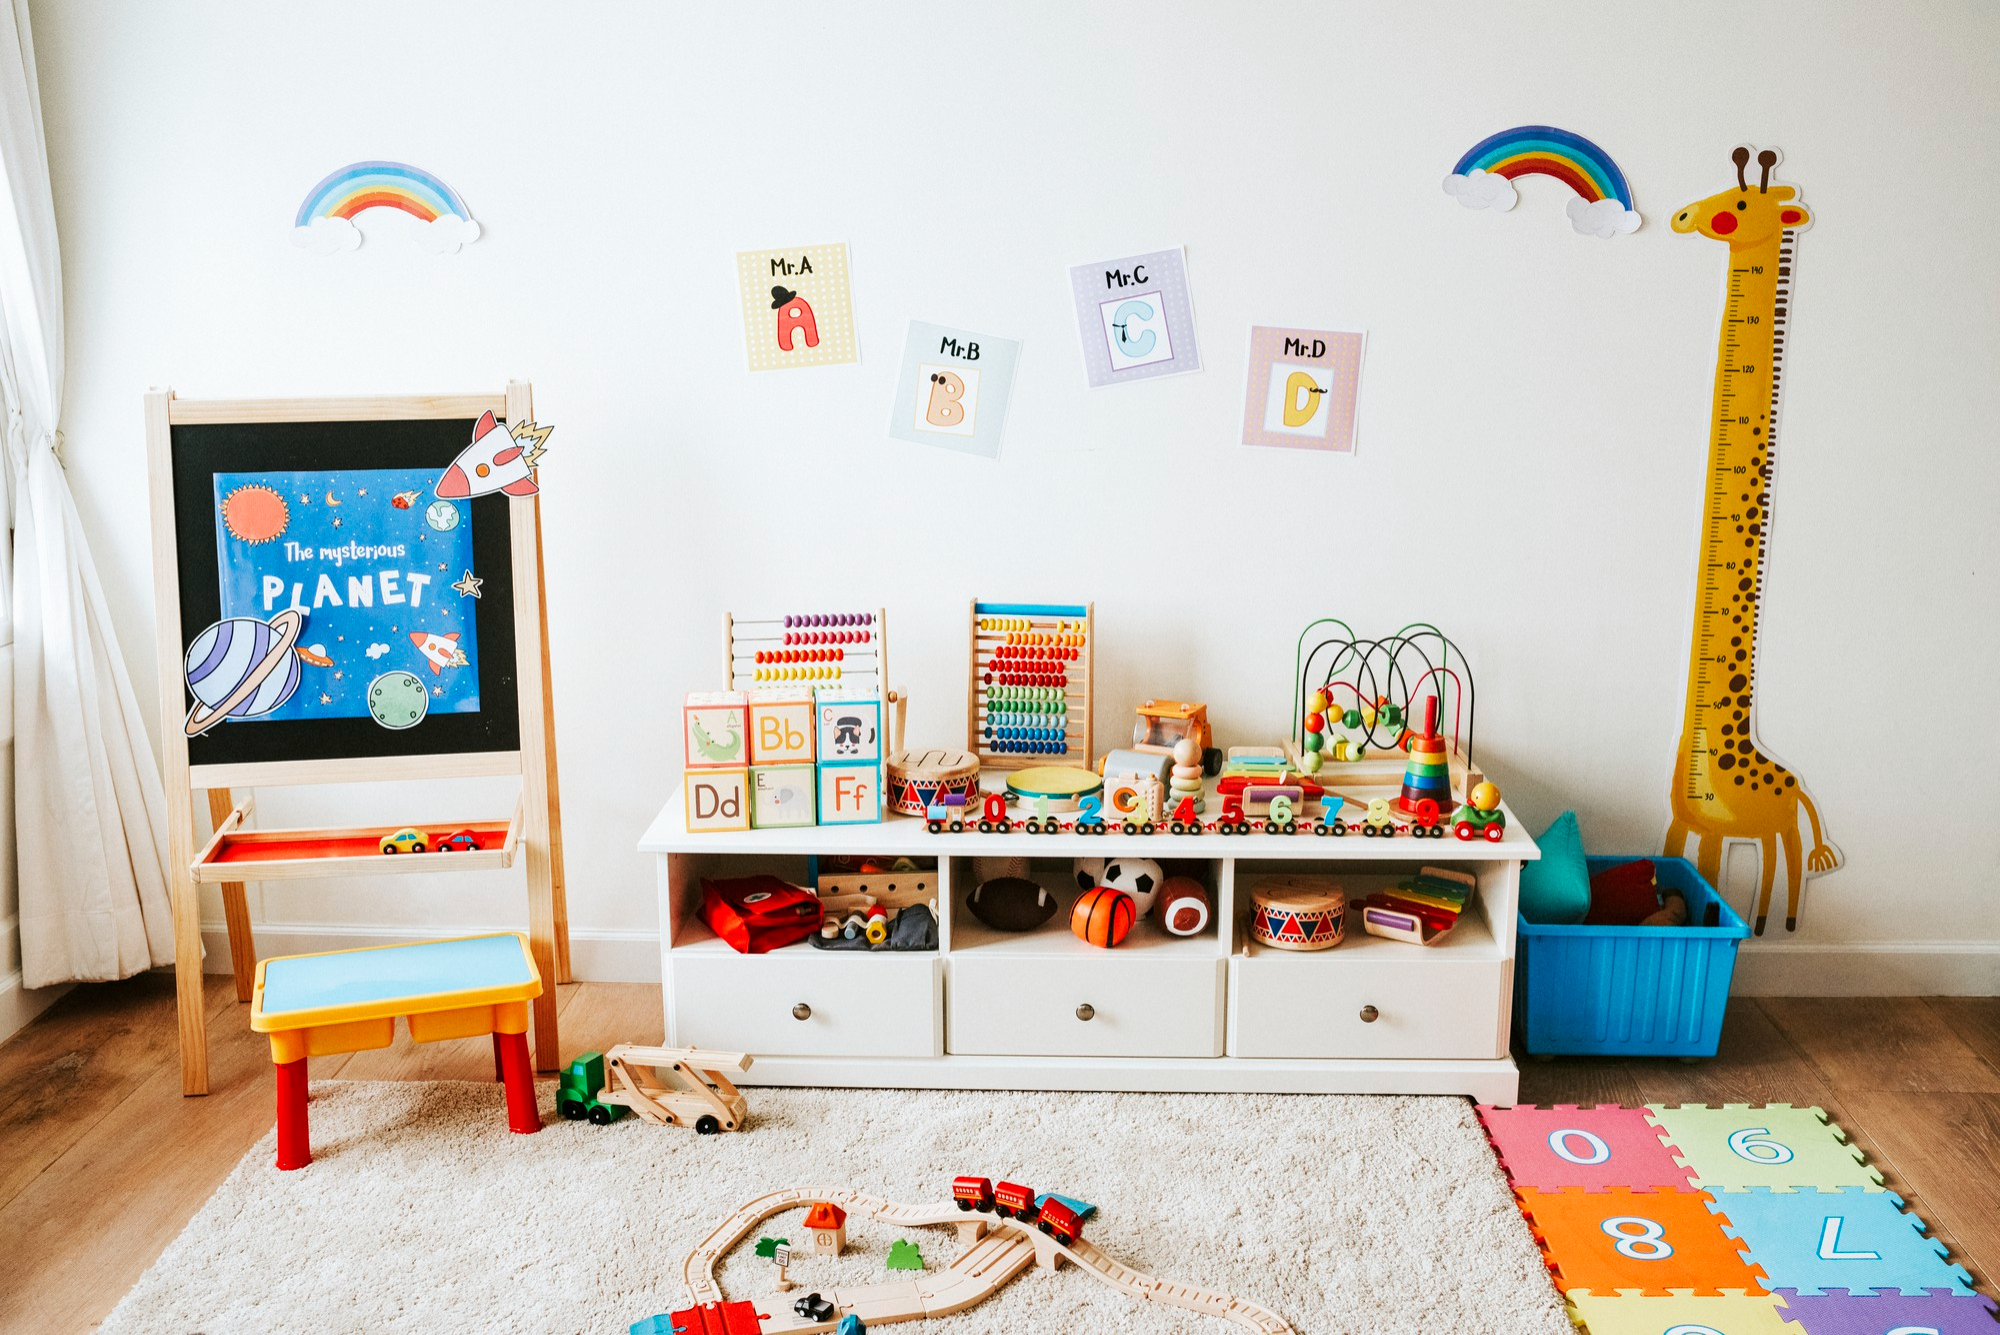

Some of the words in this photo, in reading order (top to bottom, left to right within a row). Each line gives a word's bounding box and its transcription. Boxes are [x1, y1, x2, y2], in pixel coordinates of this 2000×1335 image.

[770, 256, 813, 276] Mr.A
[1751, 266, 1763, 275] 140
[1105, 265, 1149, 289] Mr.C
[777, 296, 819, 351] A
[1114, 301, 1156, 357] C
[1747, 316, 1759, 325] 130
[940, 337, 980, 361] Mr.B
[1284, 338, 1326, 358] Mr.D
[1742, 365, 1755, 374] 120
[926, 371, 964, 426] B
[1283, 372, 1320, 427] D
[1739, 416, 1749, 424] 110
[1734, 466, 1746, 474] 100
[1731, 514, 1740, 522] 90
[284, 542, 313, 562] The
[319, 540, 406, 566] mysterious
[1726, 561, 1736, 570] 80
[263, 570, 431, 616] PLANET
[1721, 608, 1729, 616] 70
[1717, 655, 1726, 663] 60
[1713, 702, 1722, 710] 50
[727, 711, 737, 723] A
[760, 716, 804, 751] Bb
[757, 773, 765, 787] E
[695, 784, 740, 819] Dd
[836, 776, 867, 811] Ff
[1704, 793, 1714, 801] 30
[984, 794, 1007, 822] 0
[1033, 795, 1048, 823] 1
[1078, 796, 1102, 825] 2
[1127, 796, 1149, 825] 3
[1174, 796, 1197, 825] 4
[1221, 796, 1245, 824] 5
[1269, 795, 1292, 824] 6
[1320, 796, 1344, 825] 7
[1367, 798, 1390, 826] 8
[1415, 798, 1439, 827] 9
[1601, 1215, 1675, 1261] 8
